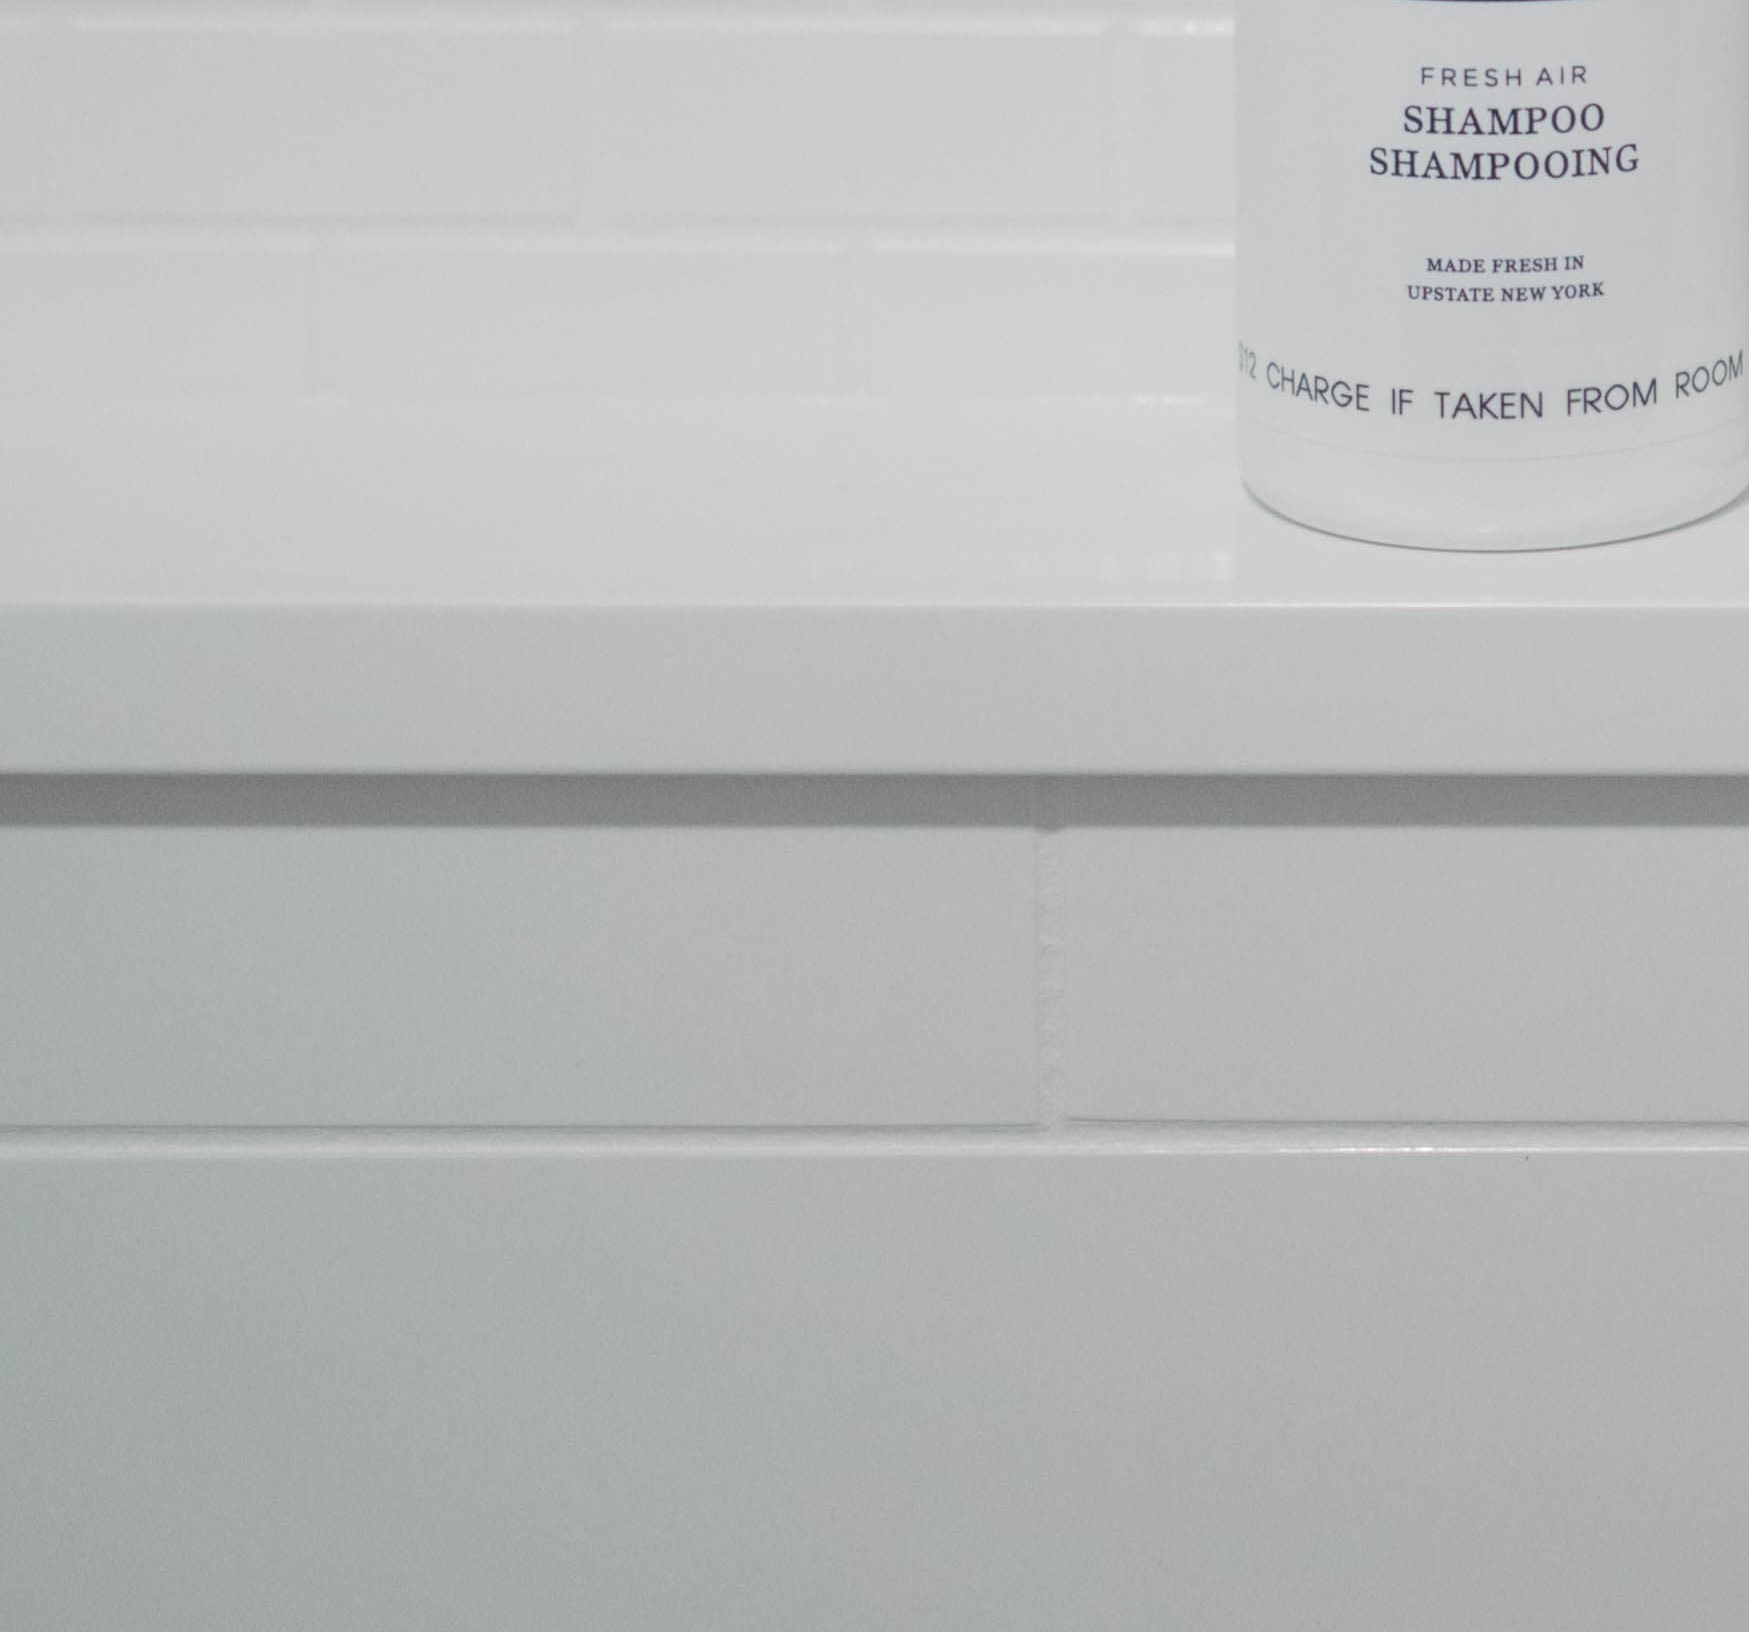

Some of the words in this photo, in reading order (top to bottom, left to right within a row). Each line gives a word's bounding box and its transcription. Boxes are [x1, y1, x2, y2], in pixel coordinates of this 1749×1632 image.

[1420, 66, 1523, 88] FRESH
[1535, 64, 1587, 87] AIR
[1403, 102, 1606, 136] SHAMPOO
[1369, 142, 1640, 182] SHAMPOOING
[1425, 257, 1487, 274] MADE
[1491, 256, 1559, 275] FRESH
[1563, 254, 1585, 272] IN
[1406, 284, 1496, 303] UPSTATE
[1500, 285, 1548, 303] NEW
[1550, 281, 1606, 301] YORK
[1265, 361, 1371, 413] CHARGE
[1391, 387, 1415, 416] IF
[1433, 390, 1544, 421] TAKEN
[1566, 376, 1658, 417] FROM
[1674, 349, 1744, 400] ROOM
